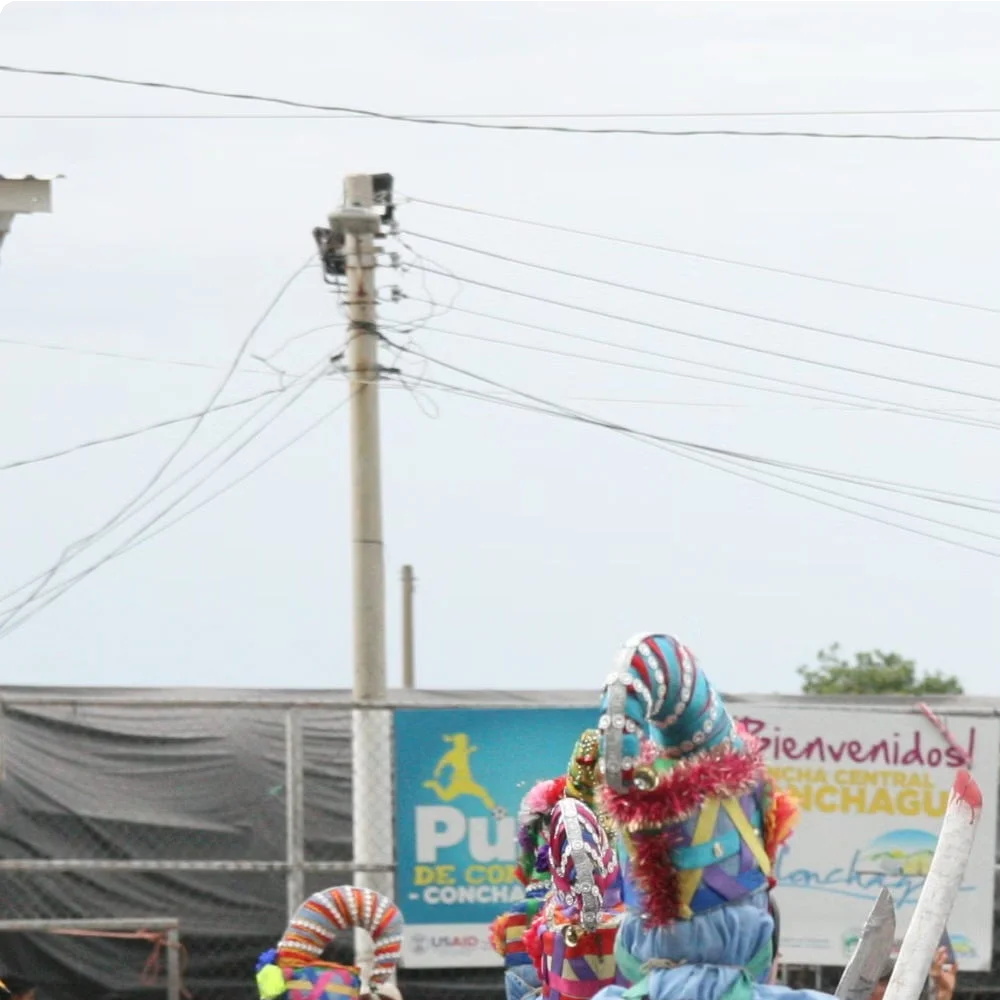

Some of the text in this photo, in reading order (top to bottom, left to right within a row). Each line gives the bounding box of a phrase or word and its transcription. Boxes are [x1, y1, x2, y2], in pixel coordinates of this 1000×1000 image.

[734, 715, 976, 769] Bienvenidos!
[834, 768, 935, 789] CENTRAL
[415, 805, 517, 863] Pu
[414, 866, 457, 885] DE
[409, 885, 526, 905] -CONCHA
[431, 936, 478, 947] USAID
